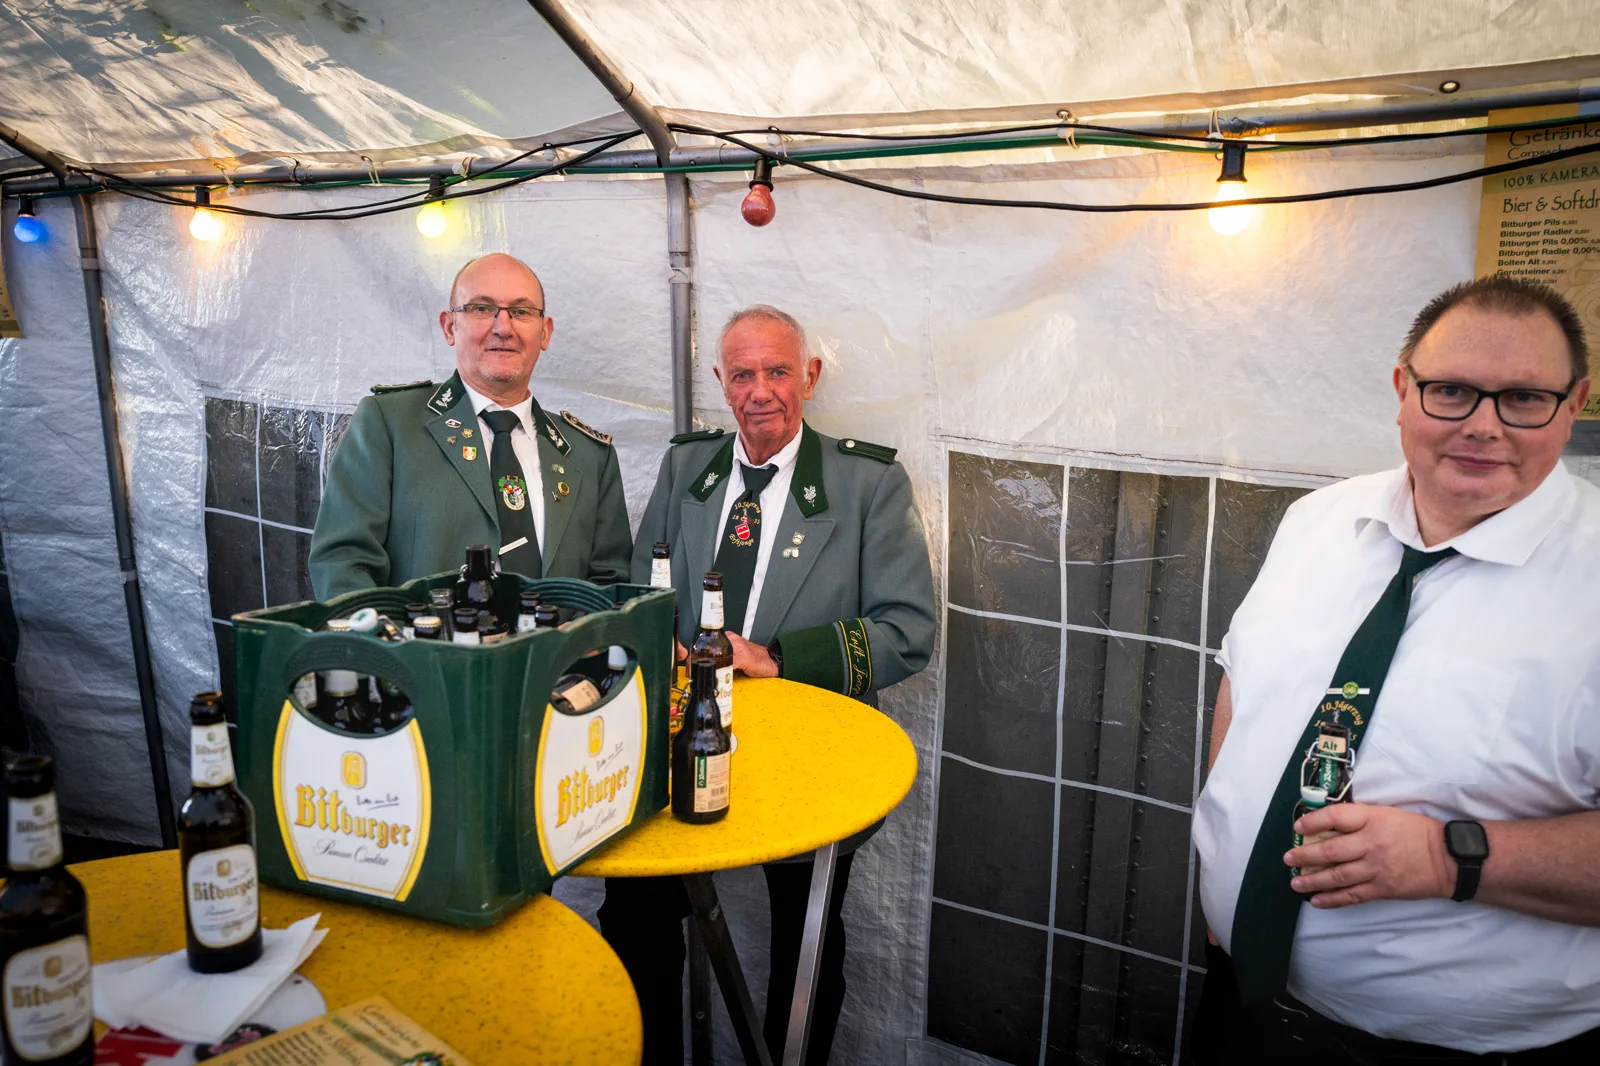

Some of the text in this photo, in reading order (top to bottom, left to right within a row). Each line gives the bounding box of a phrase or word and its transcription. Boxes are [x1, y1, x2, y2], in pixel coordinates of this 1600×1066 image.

[1503, 174, 1535, 188] 100%
[1502, 197, 1532, 213] Bier
[1535, 197, 1547, 212] &
[1501, 220, 1541, 228] Bitburger
[1500, 230, 1541, 238] Bitburger
[1543, 228, 1572, 236] Radler
[1499, 240, 1540, 248] Bitburger
[1560, 237, 1588, 245] 0,00%
[1498, 249, 1539, 257] Bitburger
[1541, 247, 1570, 255] Radler
[1496, 268, 1550, 276] Gerolsteiner
[1322, 741, 1338, 751] Alt
[555, 765, 629, 828] Bitburger
[295, 783, 411, 848] Bitburger
[192, 877, 256, 902] Bitburger
